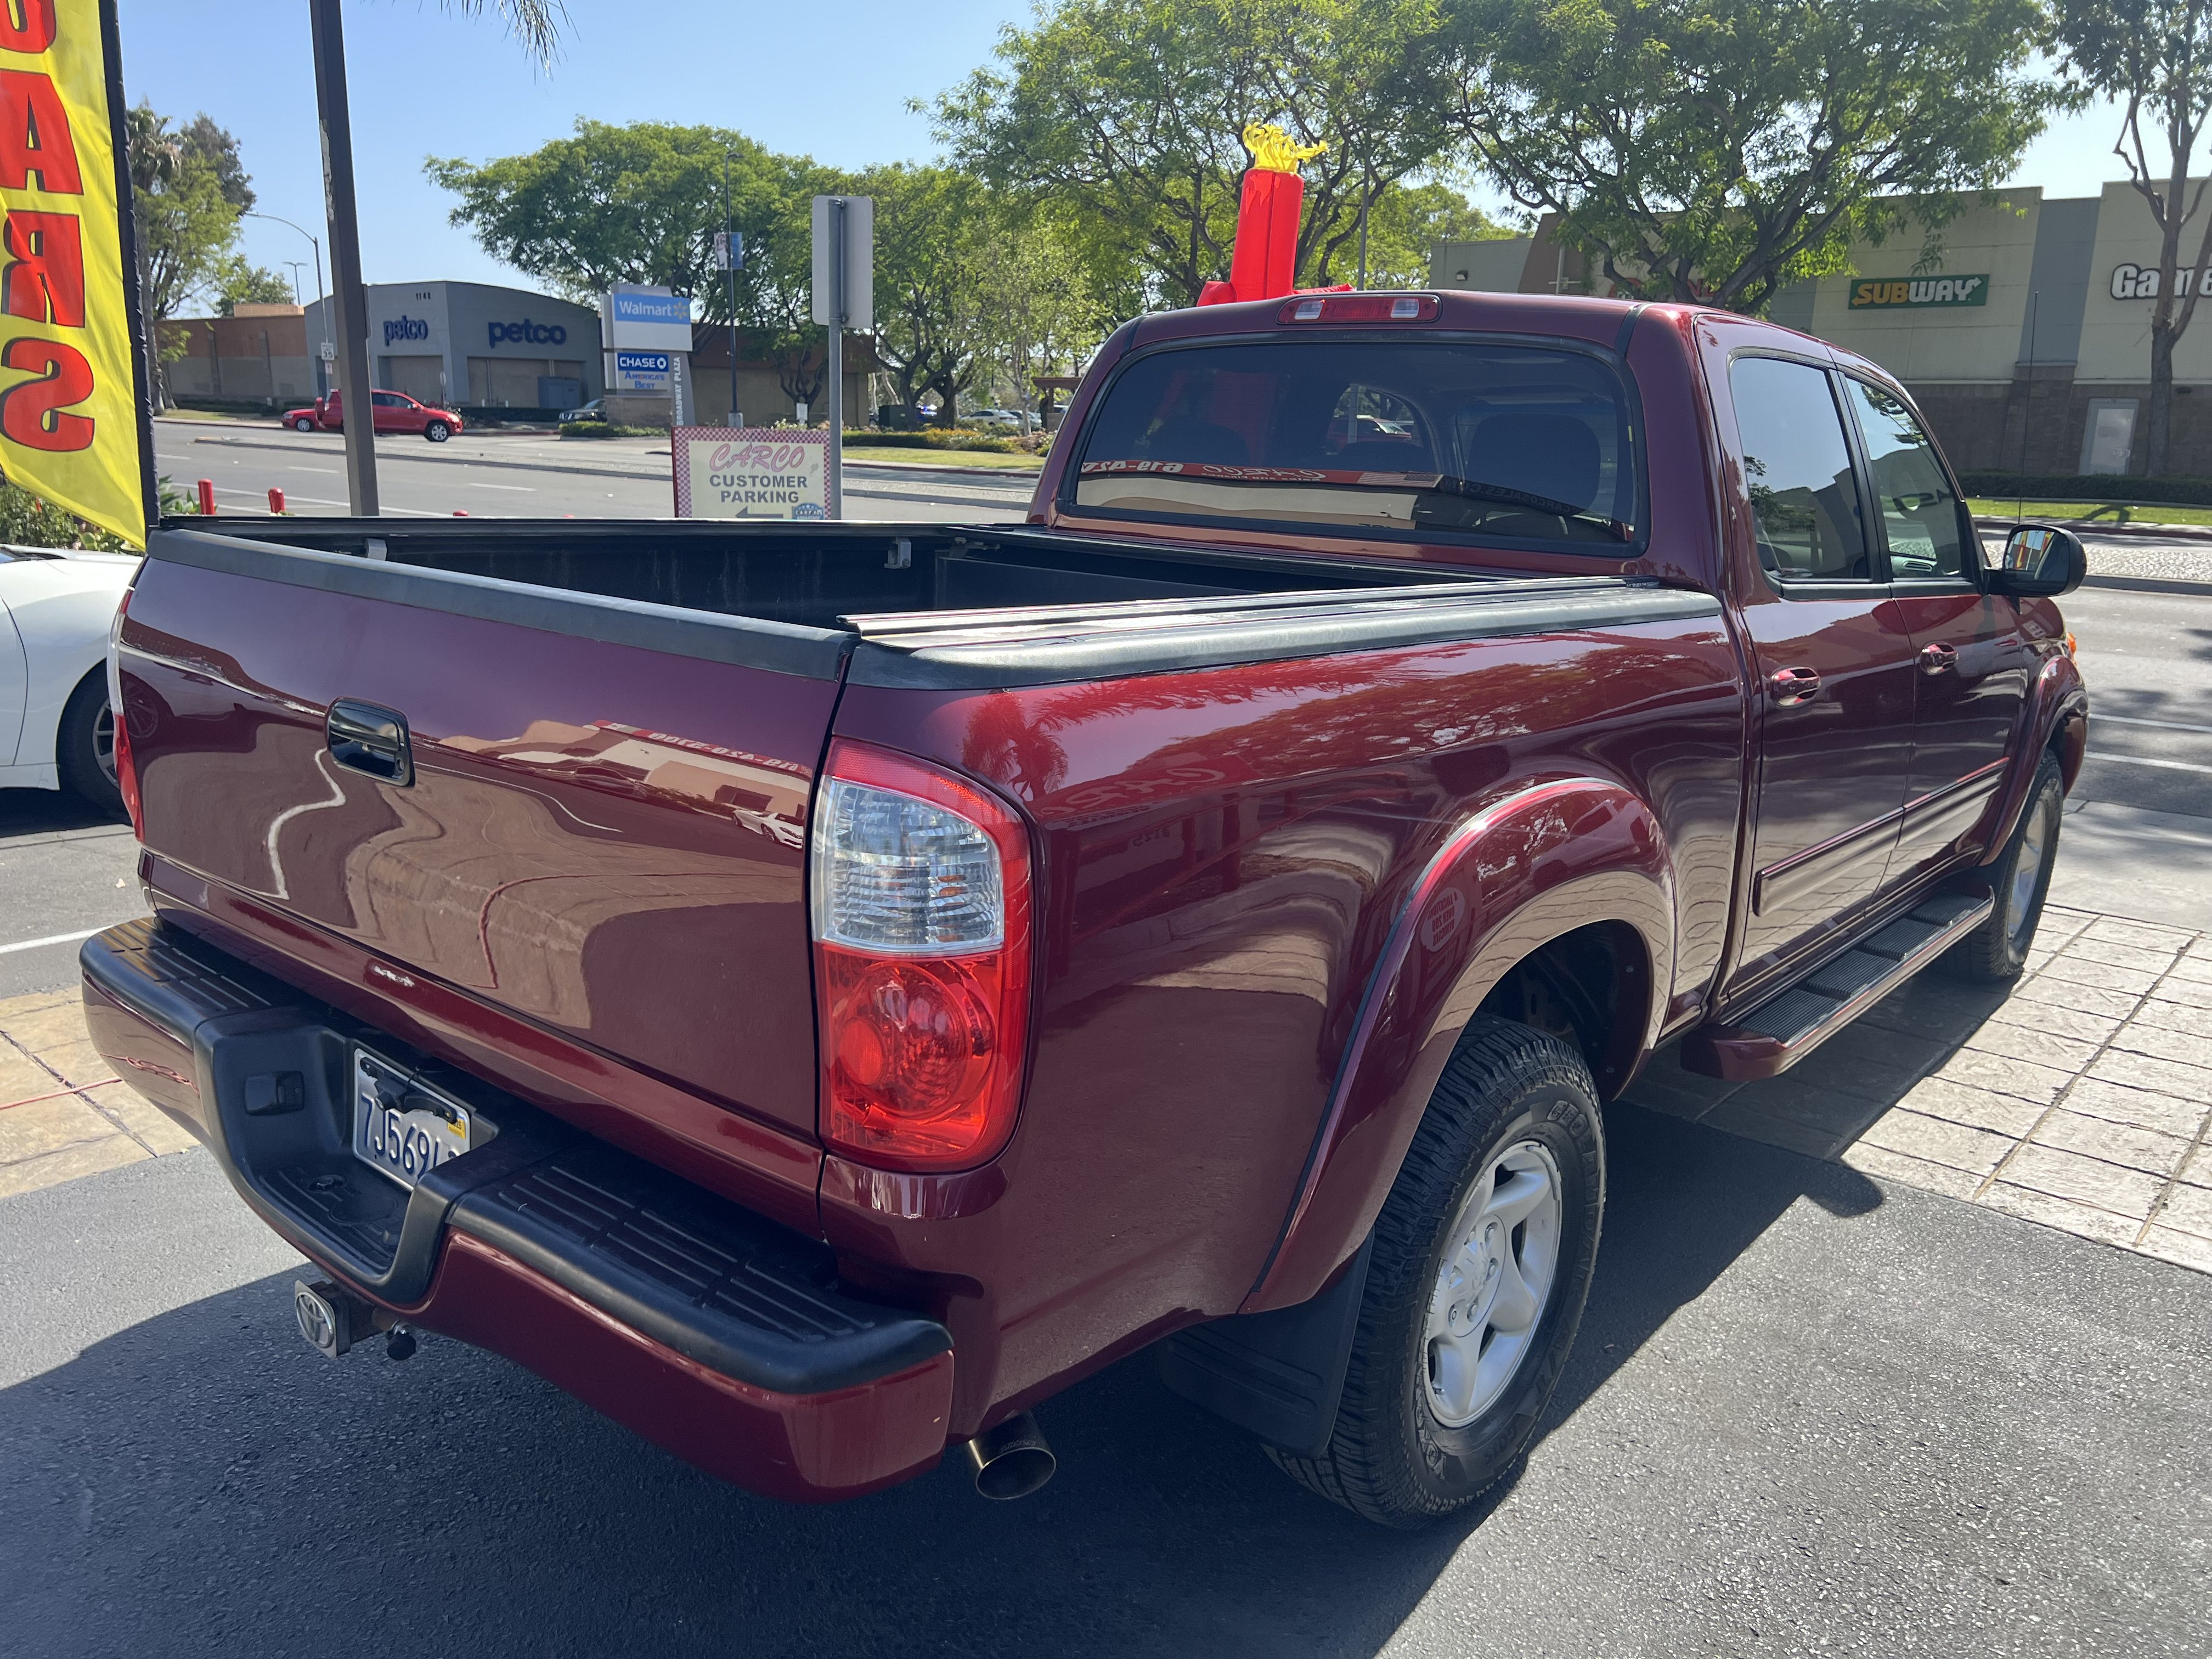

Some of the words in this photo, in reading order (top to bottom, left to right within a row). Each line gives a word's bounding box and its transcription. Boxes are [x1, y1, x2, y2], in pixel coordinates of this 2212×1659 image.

[1852, 277, 1982, 307] SUBWAY
[619, 300, 672, 317] Walmart
[383, 314, 428, 347] petco
[488, 318, 567, 348] petco
[619, 356, 656, 369] CHASE
[673, 356, 681, 382] PLAZA
[709, 443, 805, 472] CARCO
[709, 474, 808, 488] CUSTOMER
[720, 490, 799, 504] PARKING
[361, 1093, 460, 1180] 7J569
